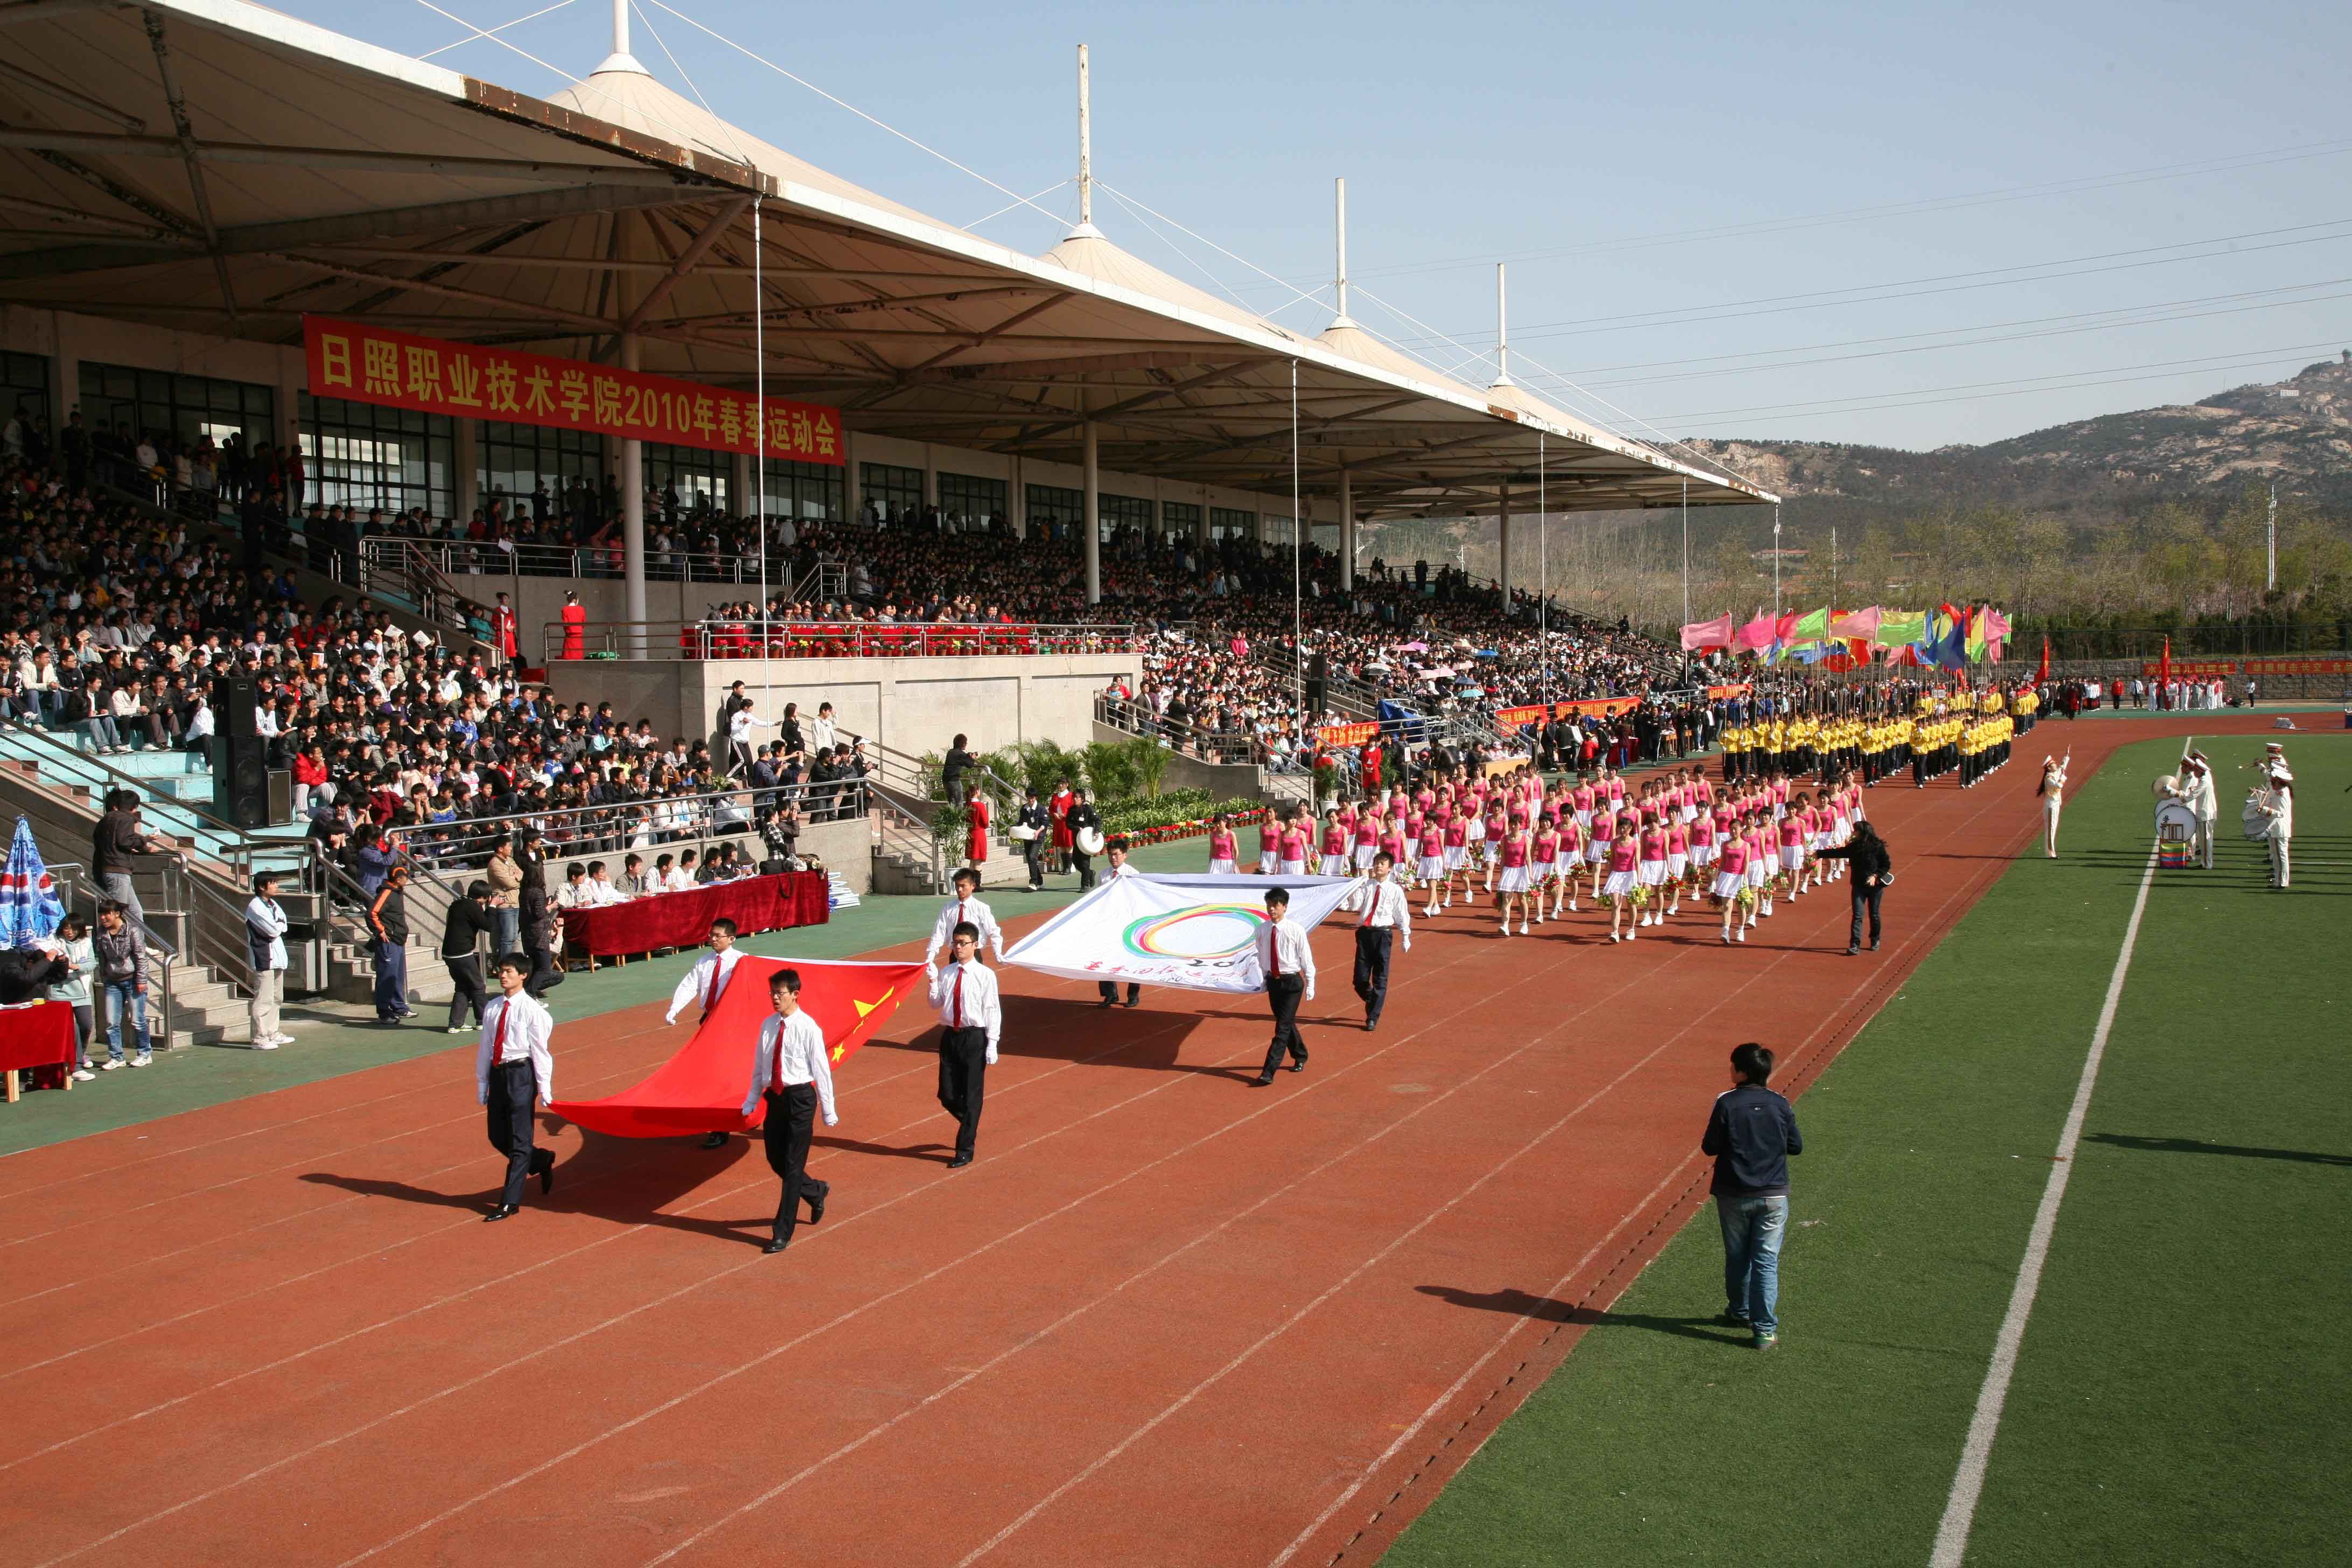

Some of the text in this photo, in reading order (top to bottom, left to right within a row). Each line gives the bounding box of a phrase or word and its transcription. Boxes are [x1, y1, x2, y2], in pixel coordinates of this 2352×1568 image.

[321, 333, 834, 457] 日照职业技术学院2010年春季运动会
